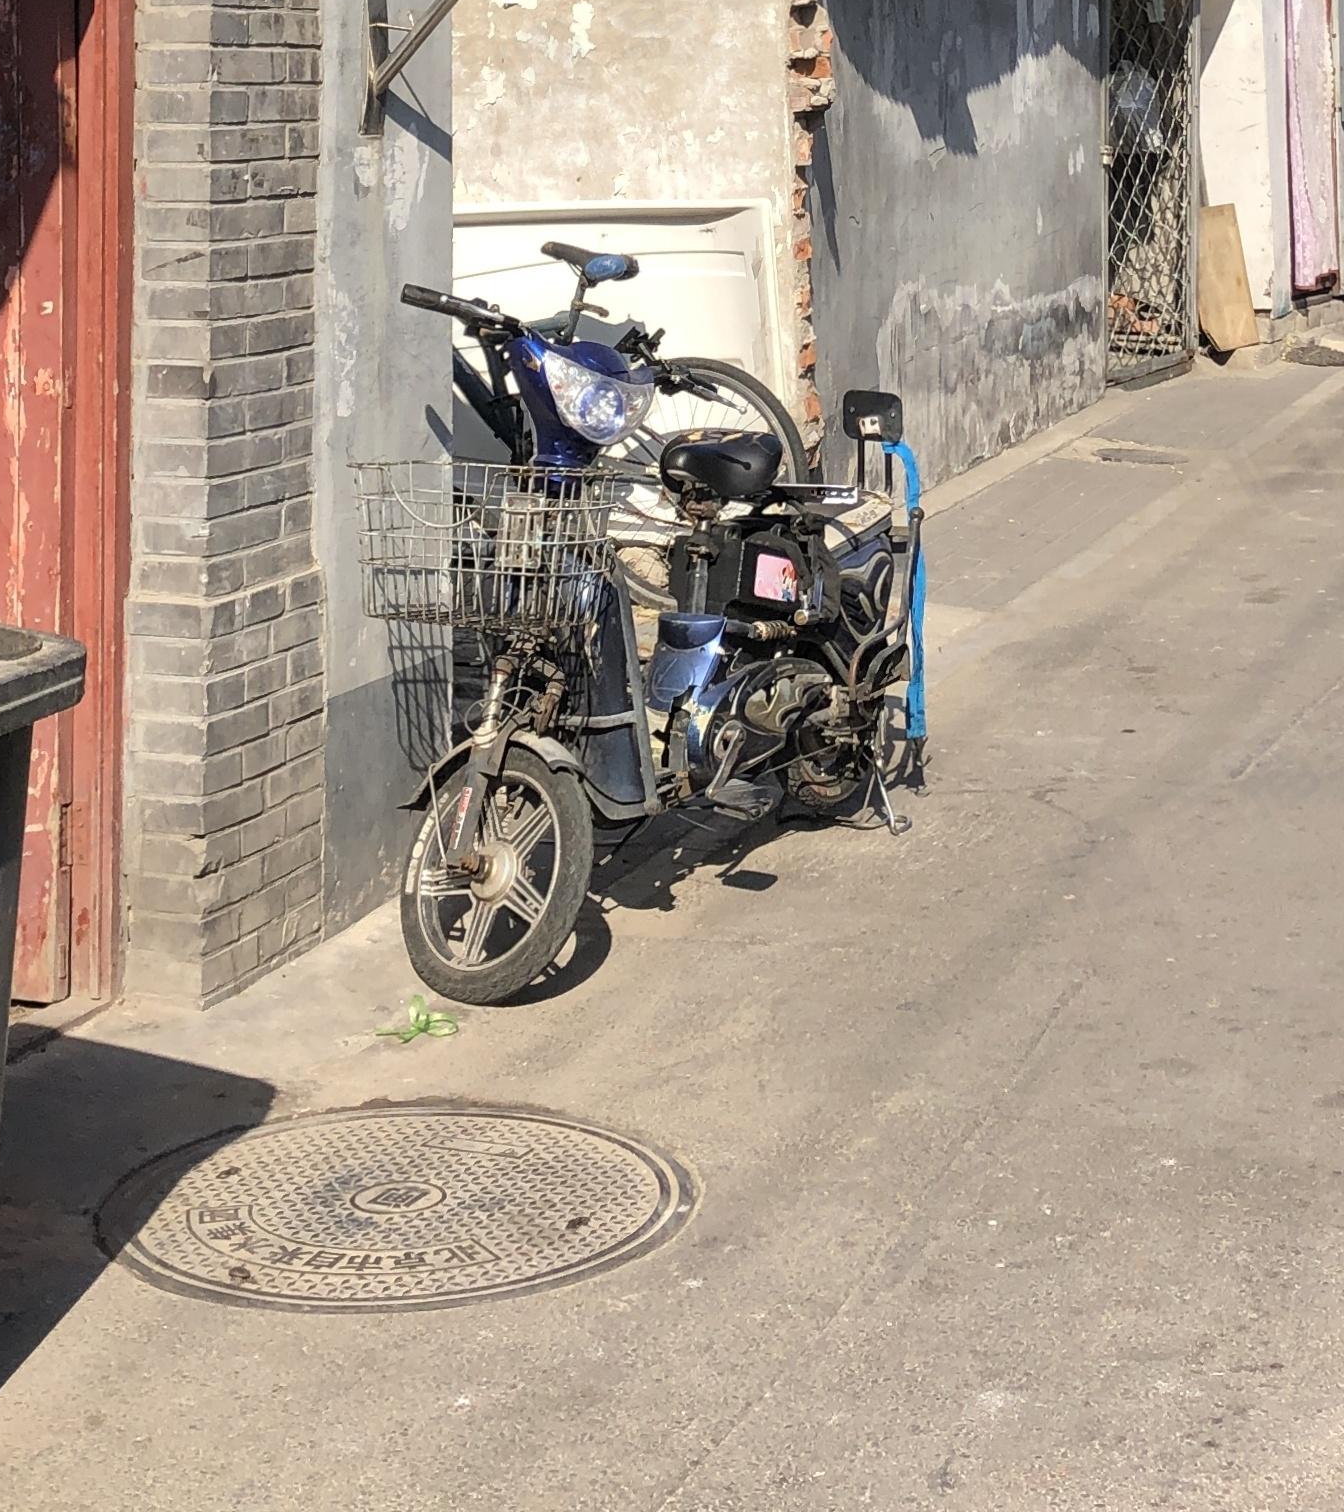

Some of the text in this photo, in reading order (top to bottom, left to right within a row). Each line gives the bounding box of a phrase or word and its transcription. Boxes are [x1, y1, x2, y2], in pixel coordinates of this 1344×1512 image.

[197, 1207, 482, 1272] 北京市自来水集团
